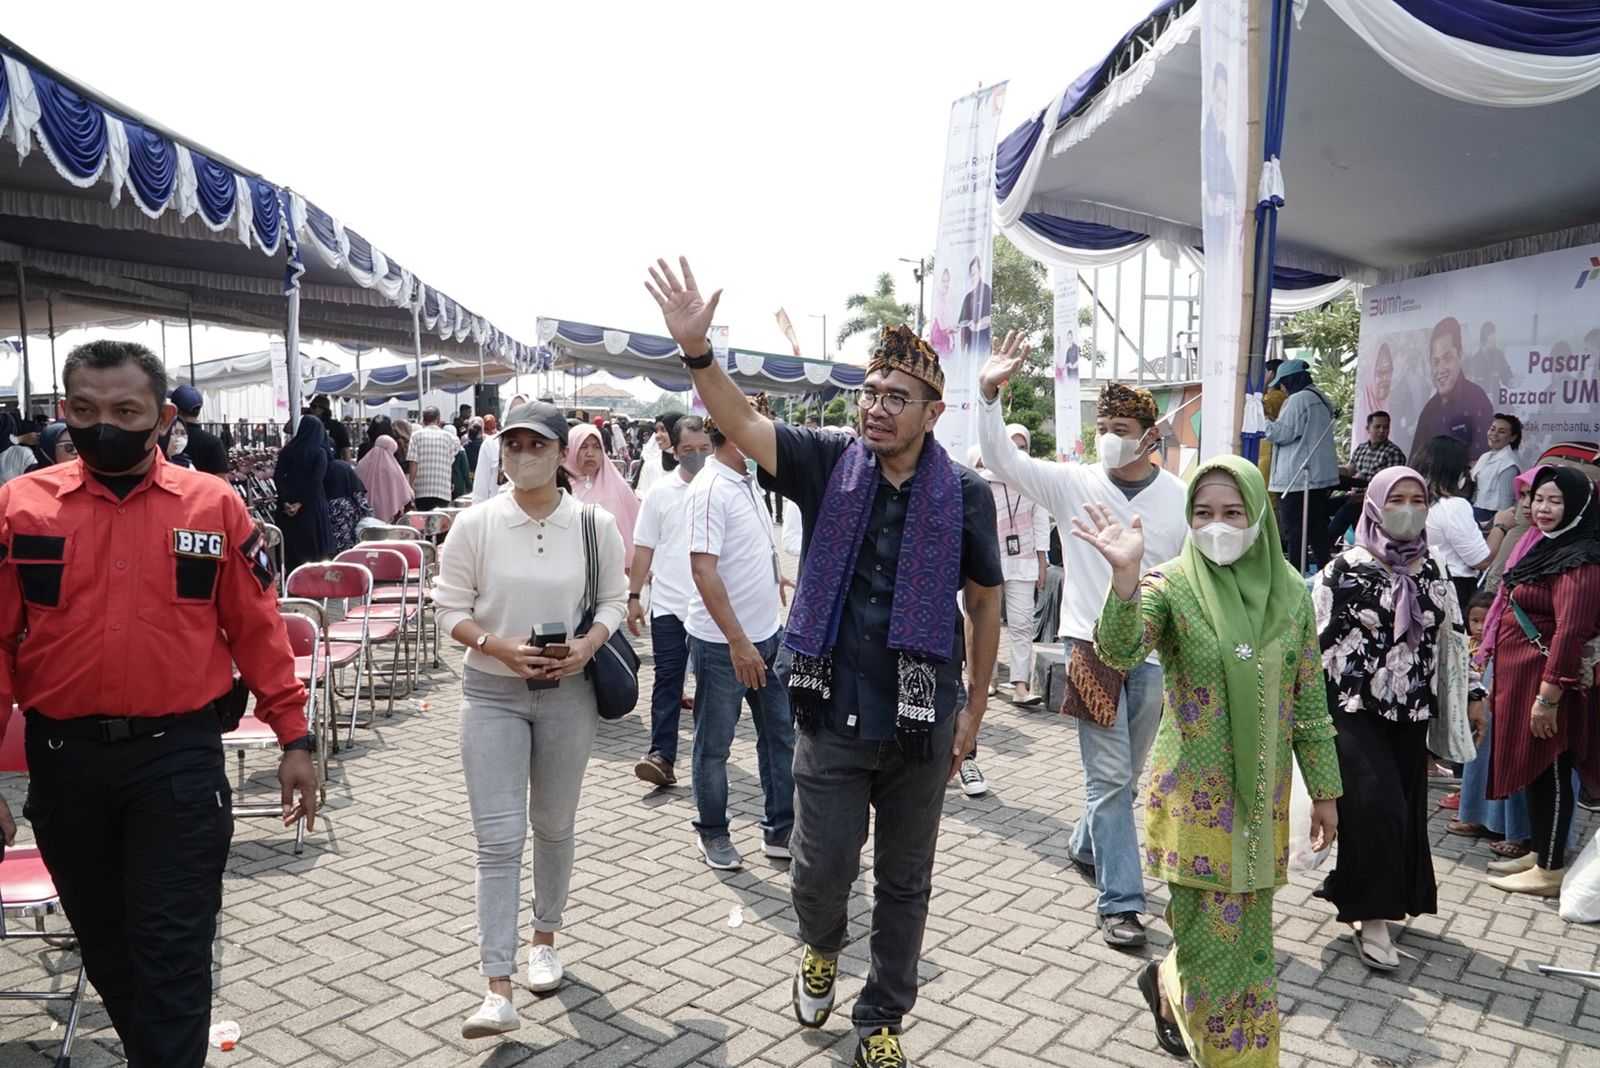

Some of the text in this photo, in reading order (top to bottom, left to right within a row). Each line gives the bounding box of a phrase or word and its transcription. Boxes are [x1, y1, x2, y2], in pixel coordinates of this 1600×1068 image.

[1528, 351, 1591, 374] Pasar
[1499, 379, 1599, 405] Bazaar UM
[1522, 421, 1539, 433] dak
[1542, 420, 1591, 433] membantu,
[178, 531, 221, 555] BFG
